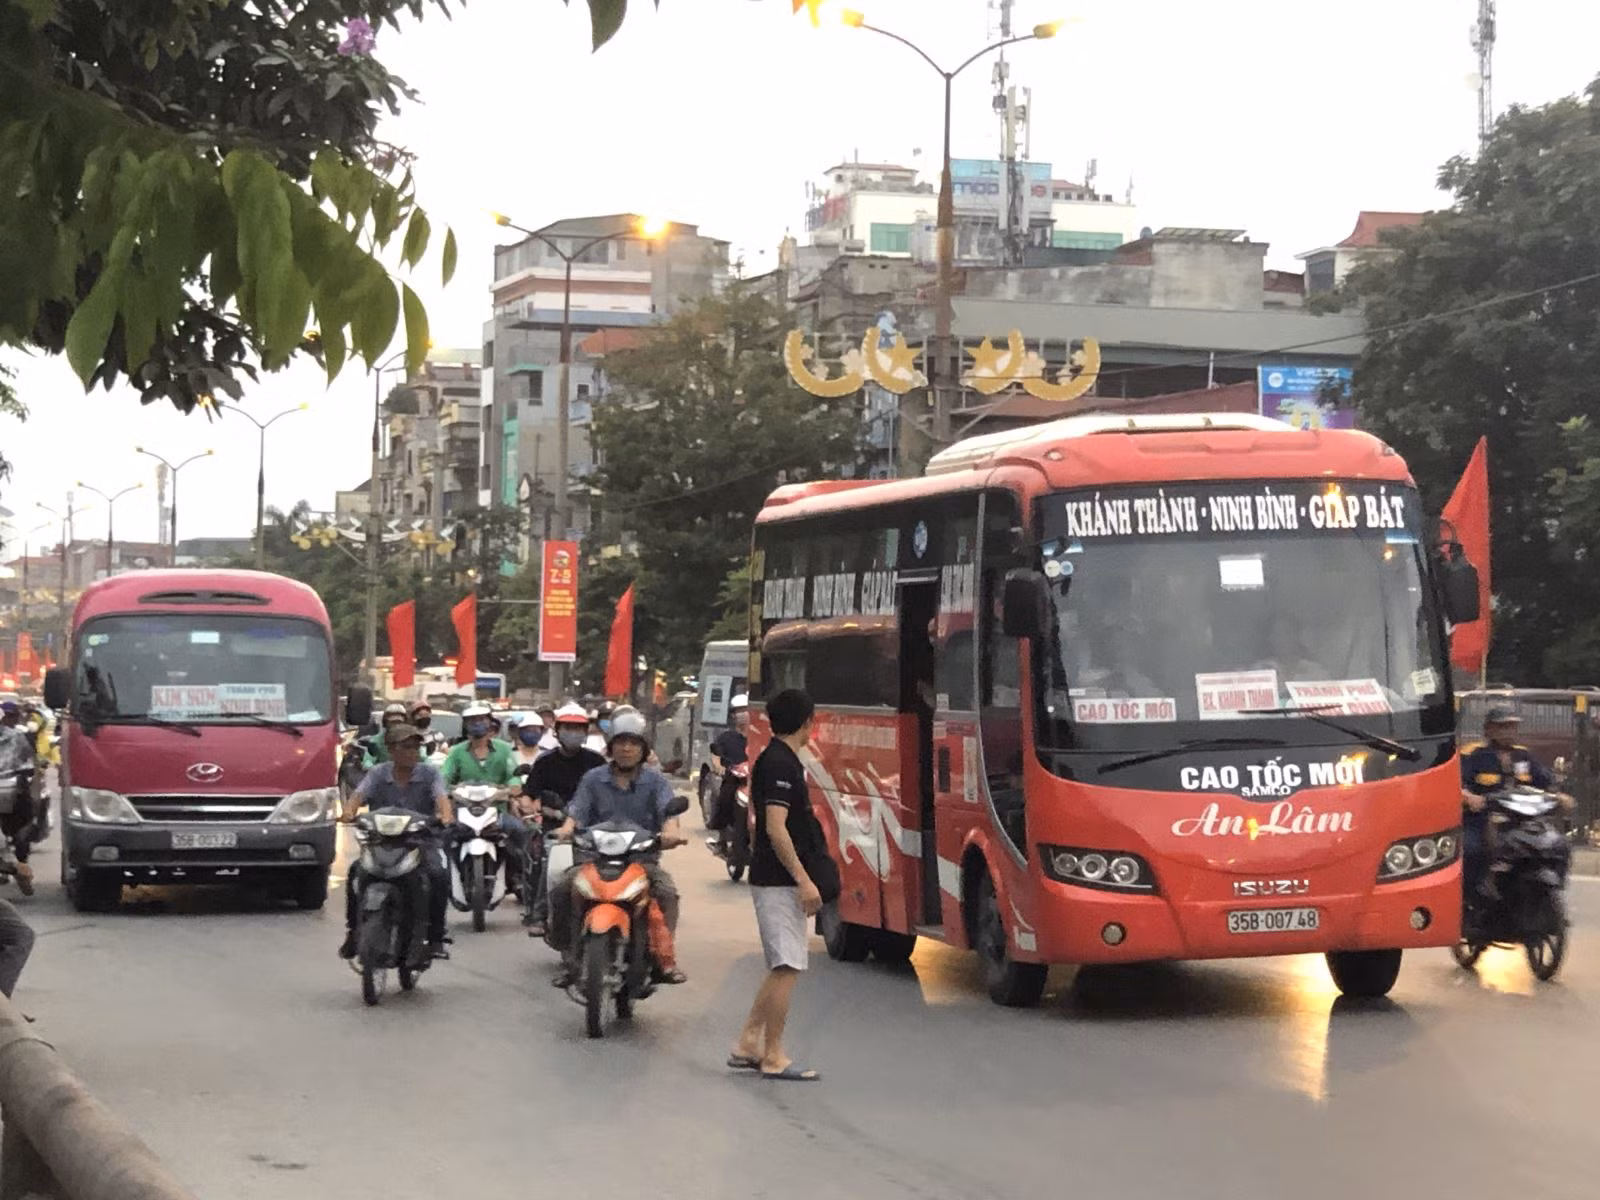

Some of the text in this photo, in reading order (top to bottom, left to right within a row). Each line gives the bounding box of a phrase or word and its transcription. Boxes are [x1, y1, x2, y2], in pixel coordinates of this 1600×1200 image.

[1065, 484, 1405, 536] KHÁNH THÀNH NINH BÌNH GIÁP BÁT
[1180, 755, 1365, 790] CAO TỐC MỚI
[1241, 786, 1291, 797] SAMCO
[1171, 801, 1356, 836] An Lâm
[1232, 879, 1310, 896] ISUZU
